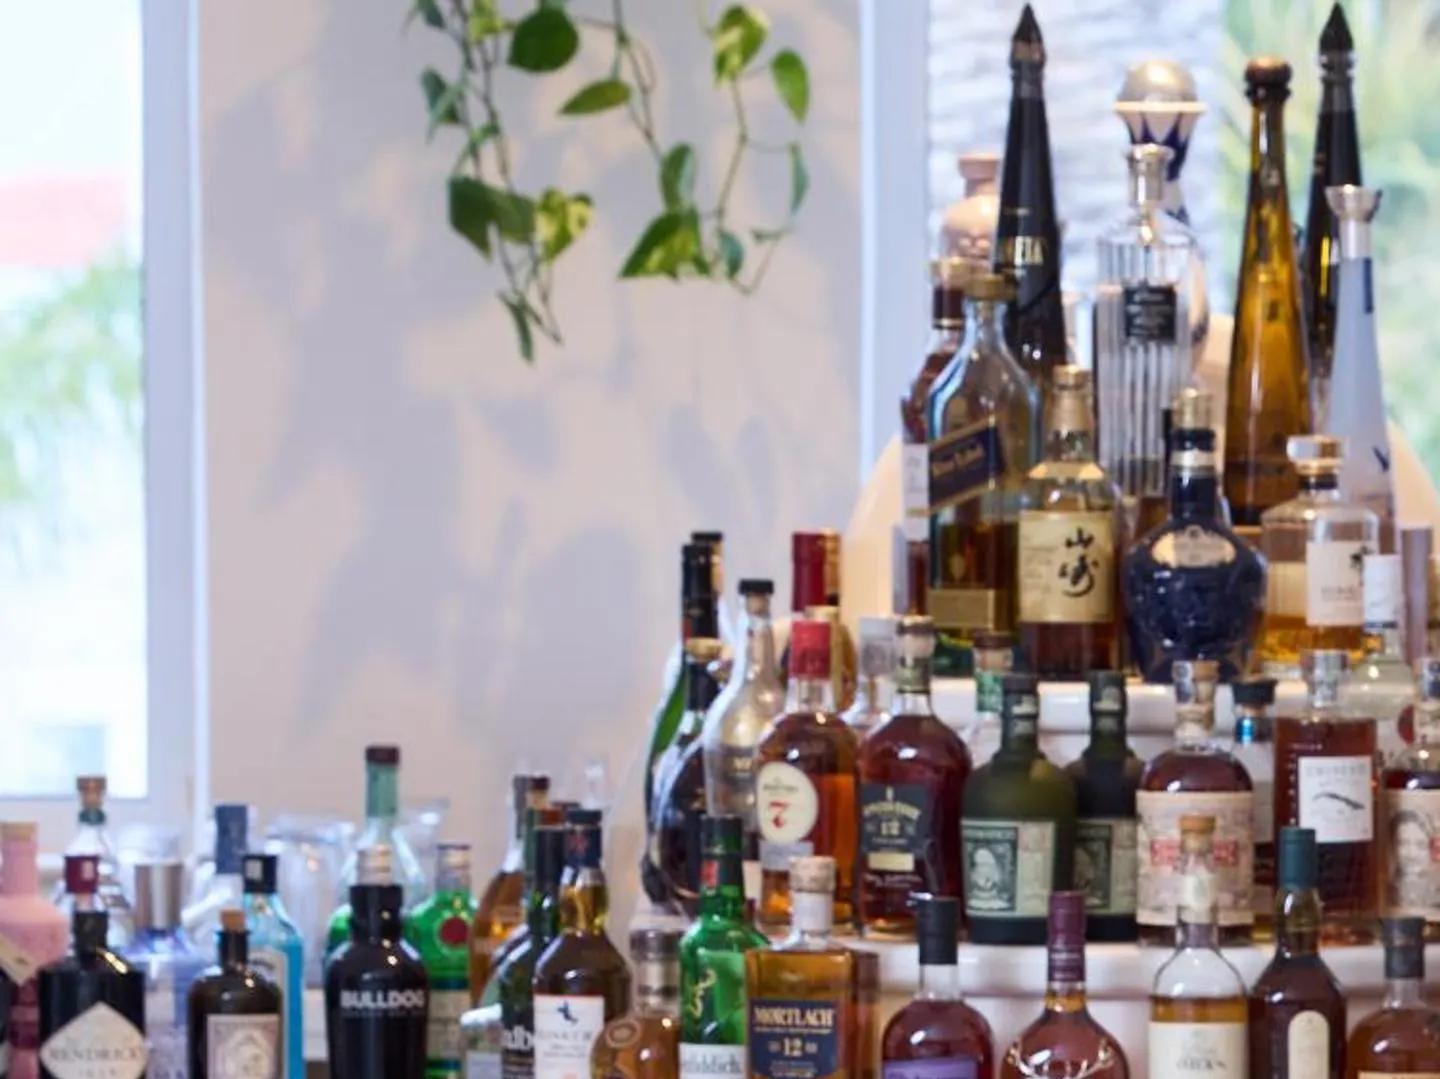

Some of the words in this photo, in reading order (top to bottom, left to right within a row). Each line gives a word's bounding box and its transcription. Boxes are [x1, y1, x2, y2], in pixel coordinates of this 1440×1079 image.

[341, 989, 424, 1009] BULLDOG
[754, 1007, 835, 1027] MORTLACH
[783, 1037, 803, 1057] 12
